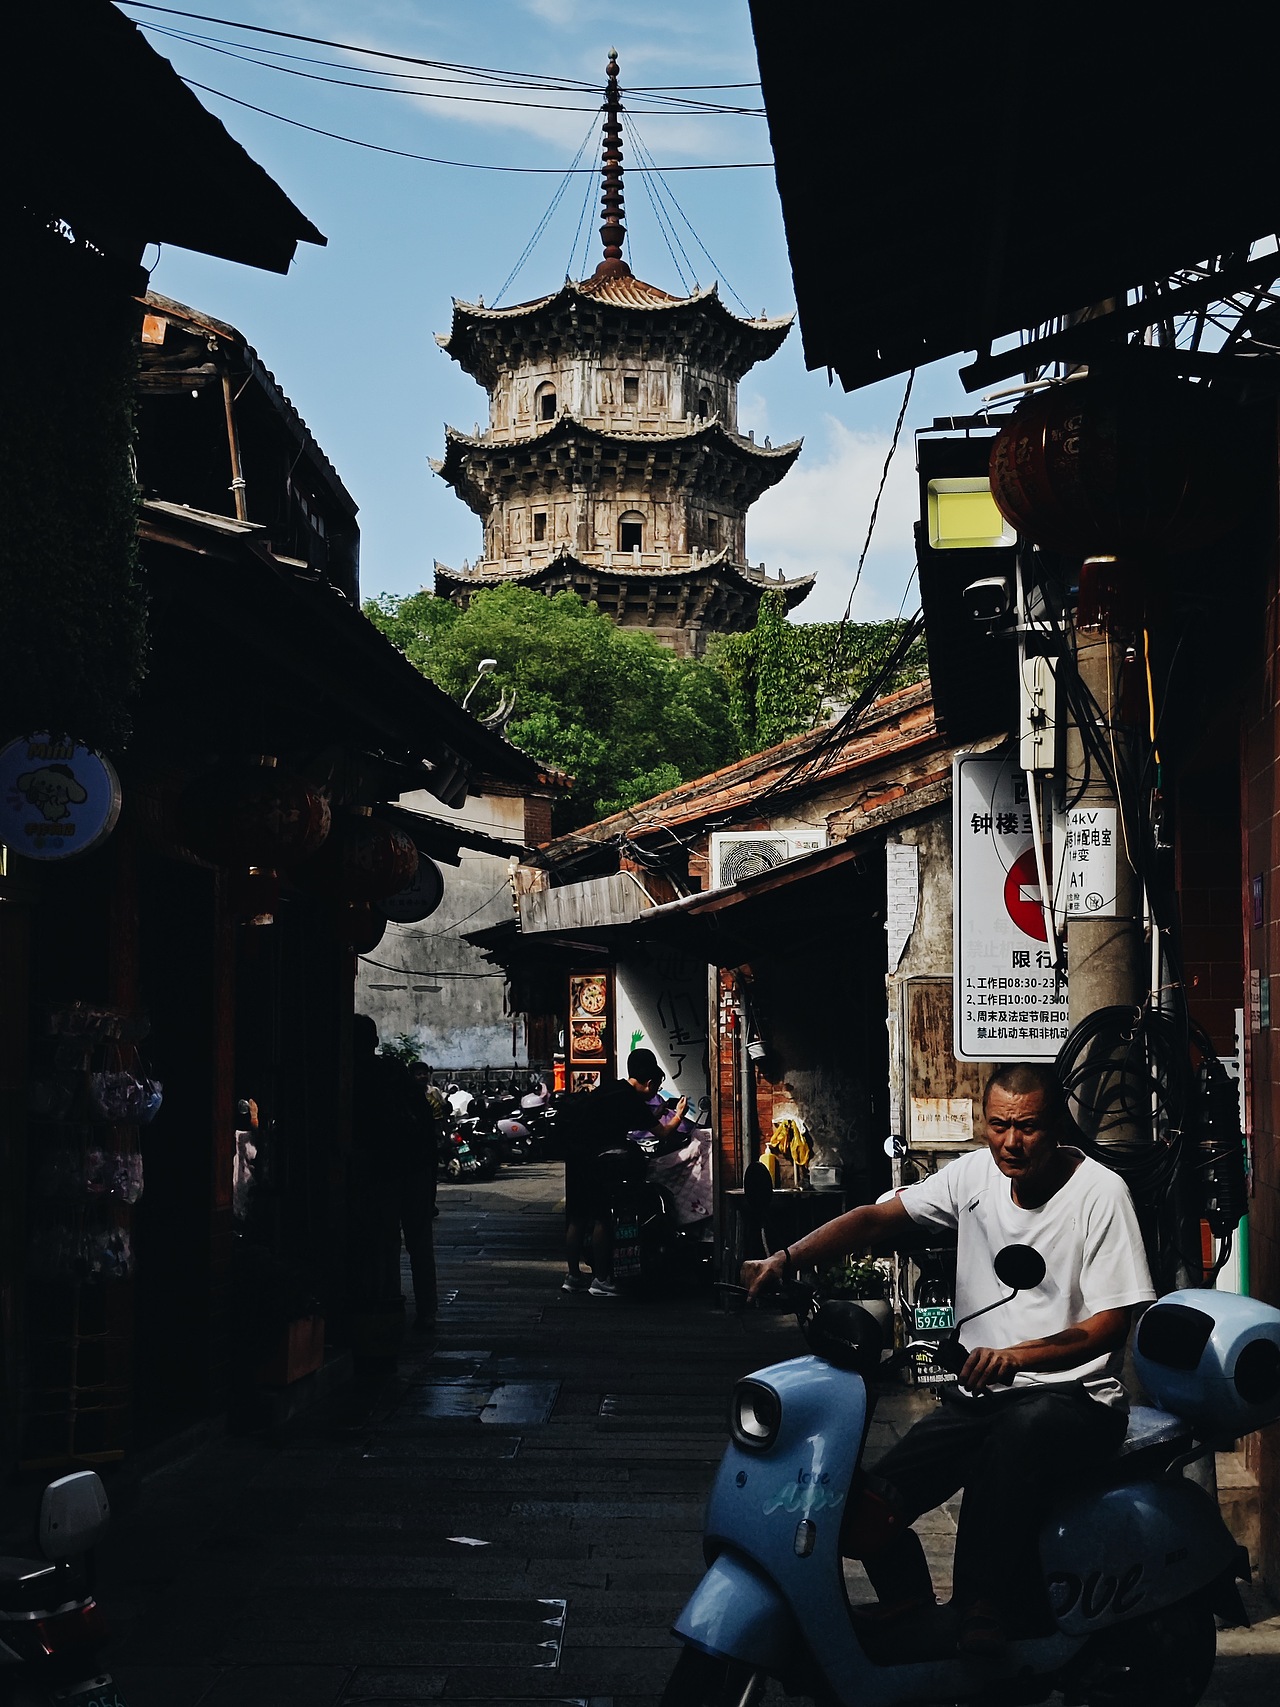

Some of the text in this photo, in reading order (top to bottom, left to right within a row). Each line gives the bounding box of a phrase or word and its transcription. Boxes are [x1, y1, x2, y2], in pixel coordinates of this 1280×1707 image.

[1067, 812, 1099, 825] .4kV
[1070, 871, 1084, 888] A1
[966, 977, 1069, 990] 1、工作日08:30-233
